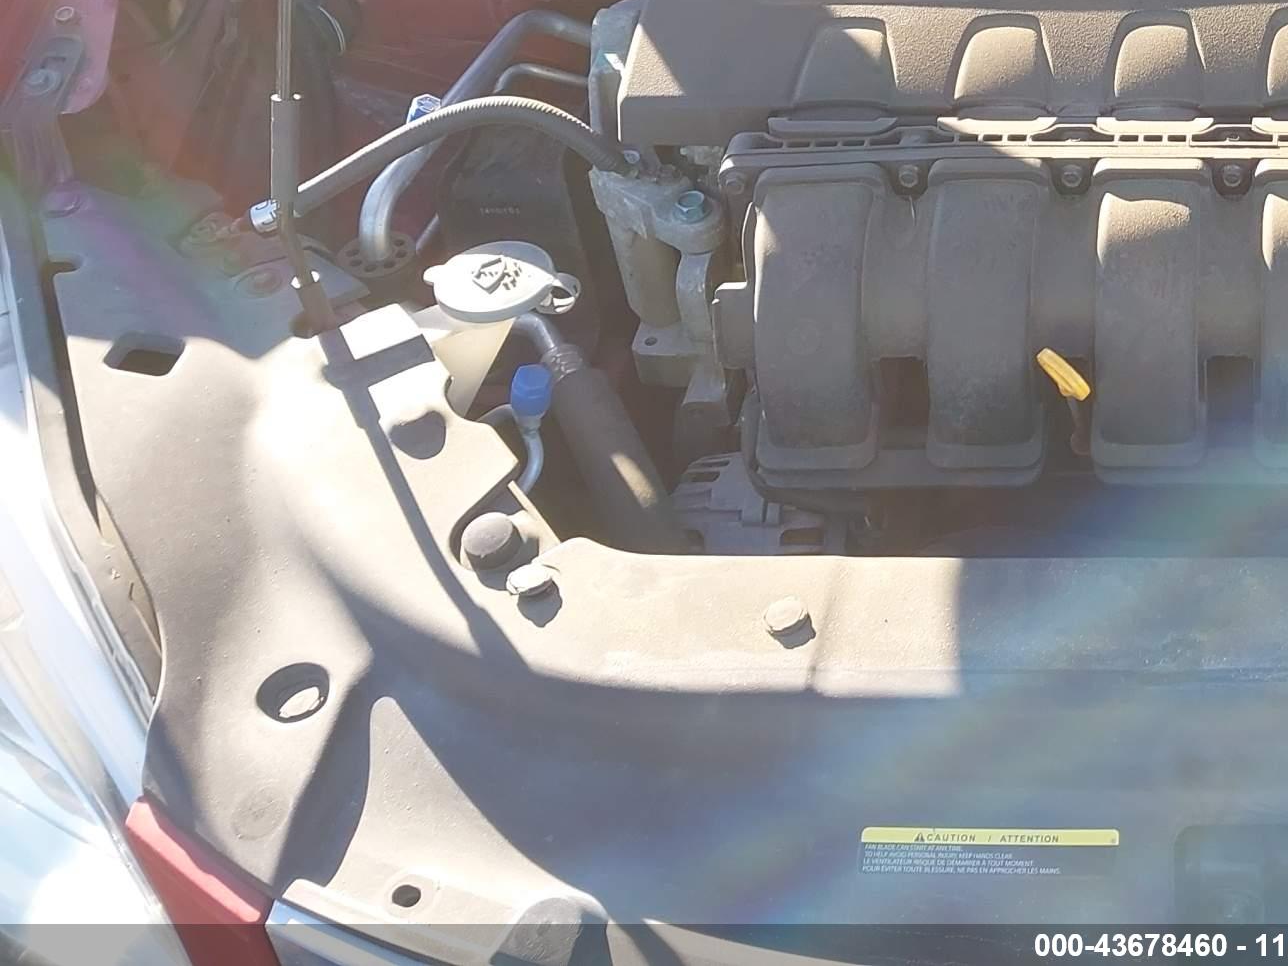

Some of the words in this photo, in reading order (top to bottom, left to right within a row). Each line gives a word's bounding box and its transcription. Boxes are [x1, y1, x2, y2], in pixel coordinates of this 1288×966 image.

[927, 834, 976, 842] CAUTION
[987, 835, 992, 843] /
[1000, 835, 1059, 843] ATTENTION
